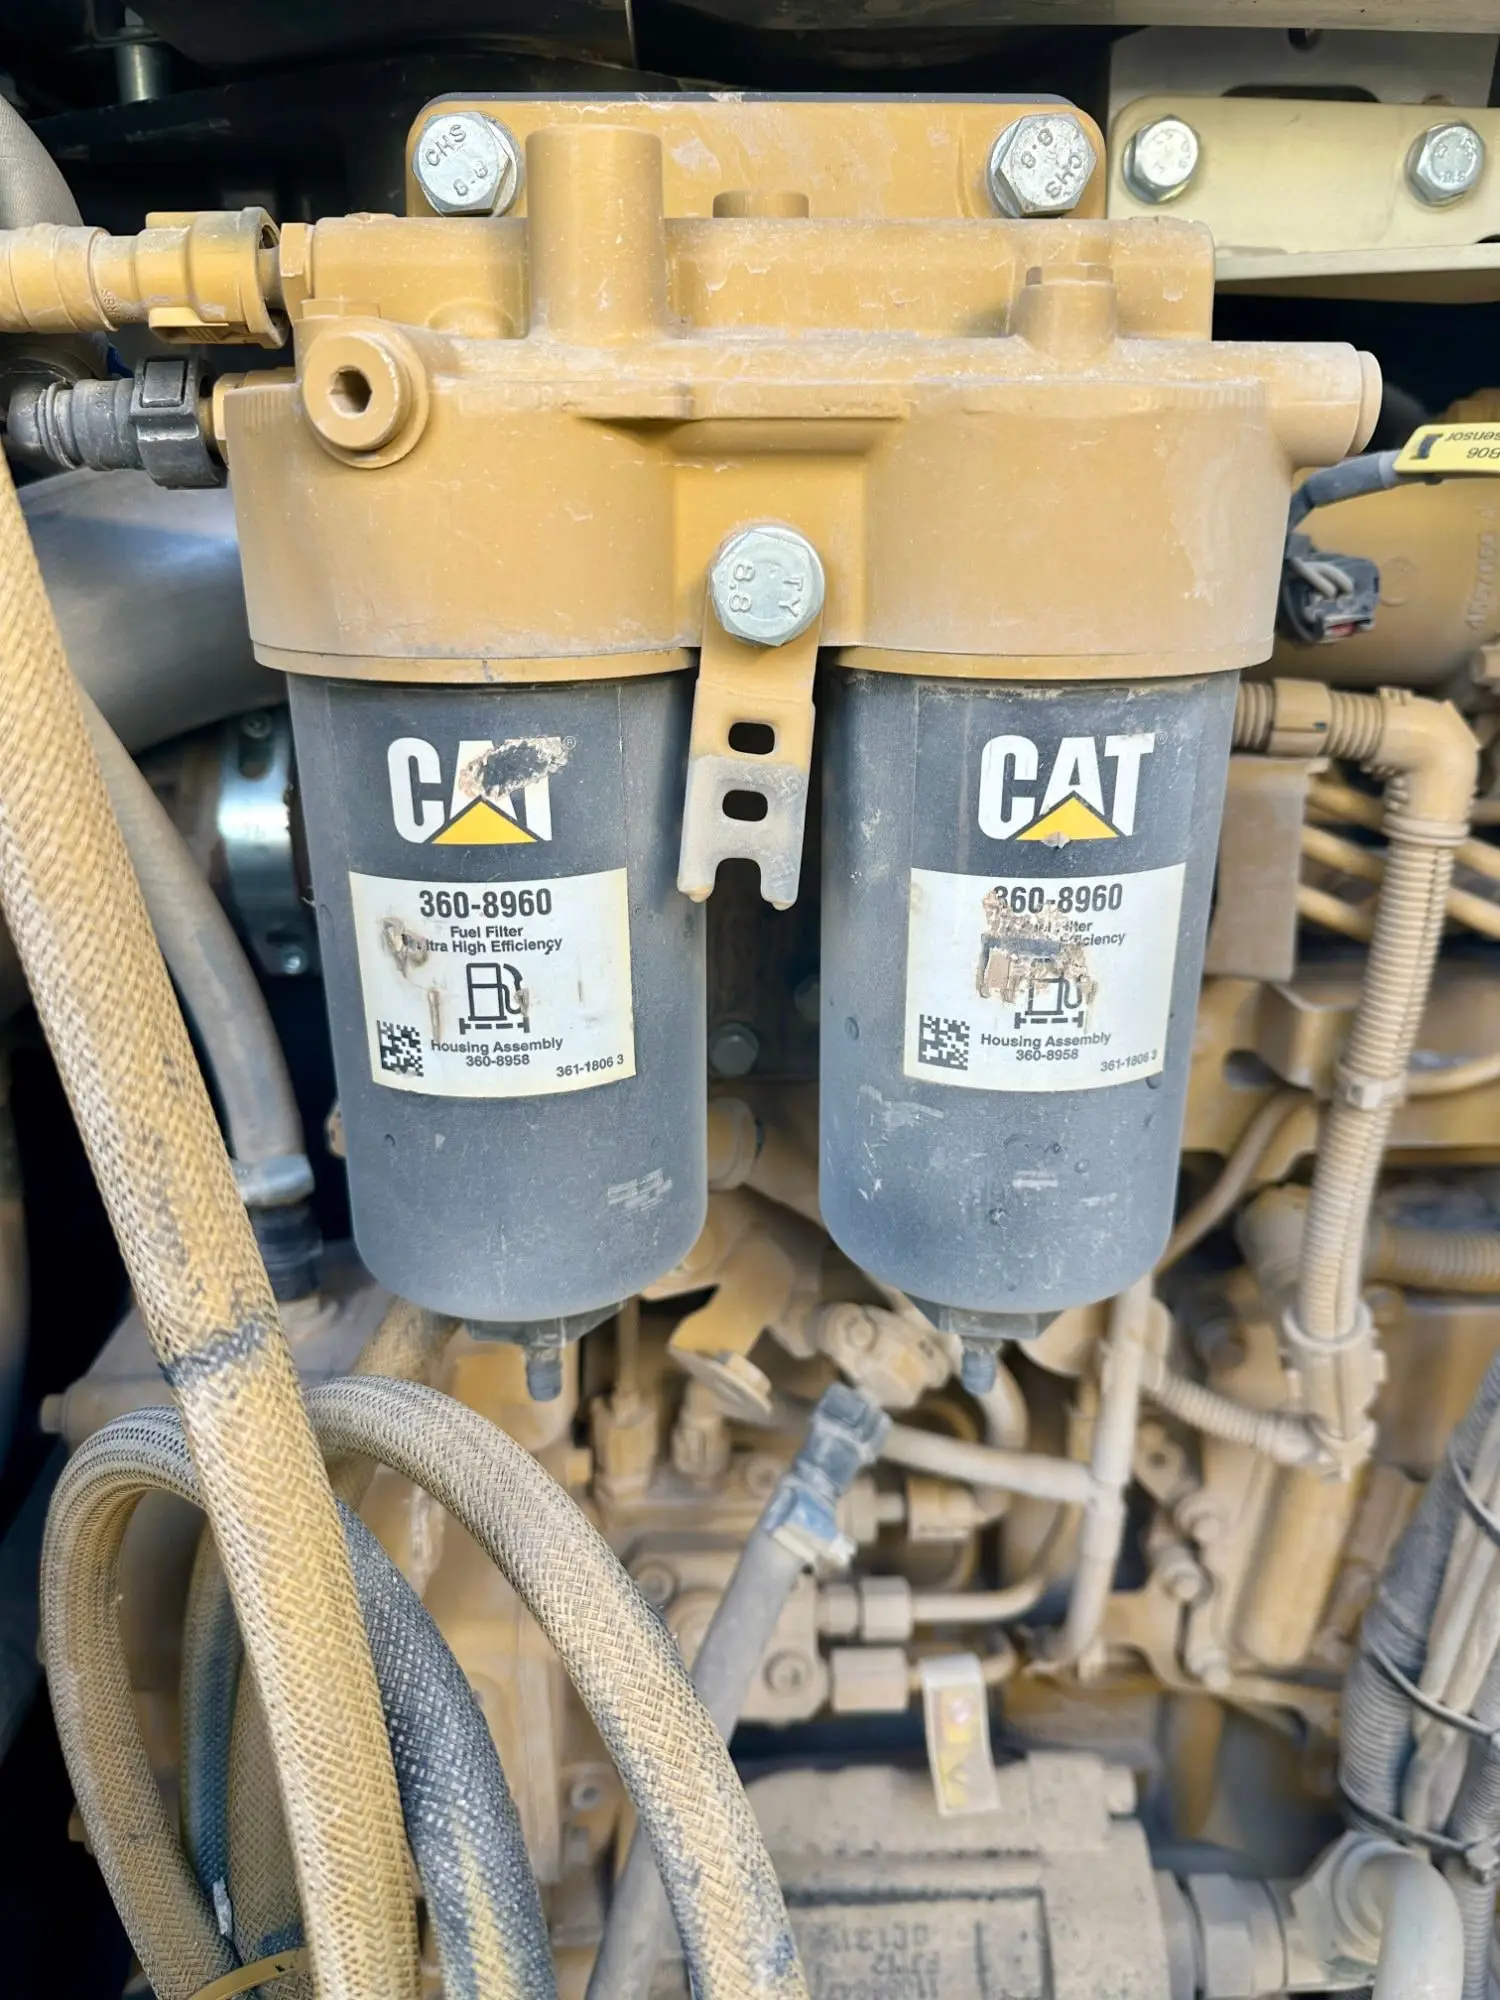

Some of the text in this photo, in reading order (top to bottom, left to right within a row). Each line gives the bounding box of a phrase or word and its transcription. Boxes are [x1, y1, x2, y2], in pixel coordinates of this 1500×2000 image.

[728, 563, 756, 613] 8.8
[778, 574, 804, 617] TY
[387, 736, 562, 843] CAT
[978, 733, 1155, 840] CAT
[419, 887, 552, 918] 360-8960
[993, 883, 1123, 914] 360-8960
[450, 925, 524, 938] Fuel Filter
[417, 938, 562, 956] ltra High Efficiency
[431, 1037, 563, 1056] Housing Assembly
[980, 1032, 1111, 1049] Housing Assembly
[466, 1054, 530, 1067] 360-8958
[556, 1054, 624, 1077] 361-1806 3
[1015, 1048, 1079, 1061] 360-8958
